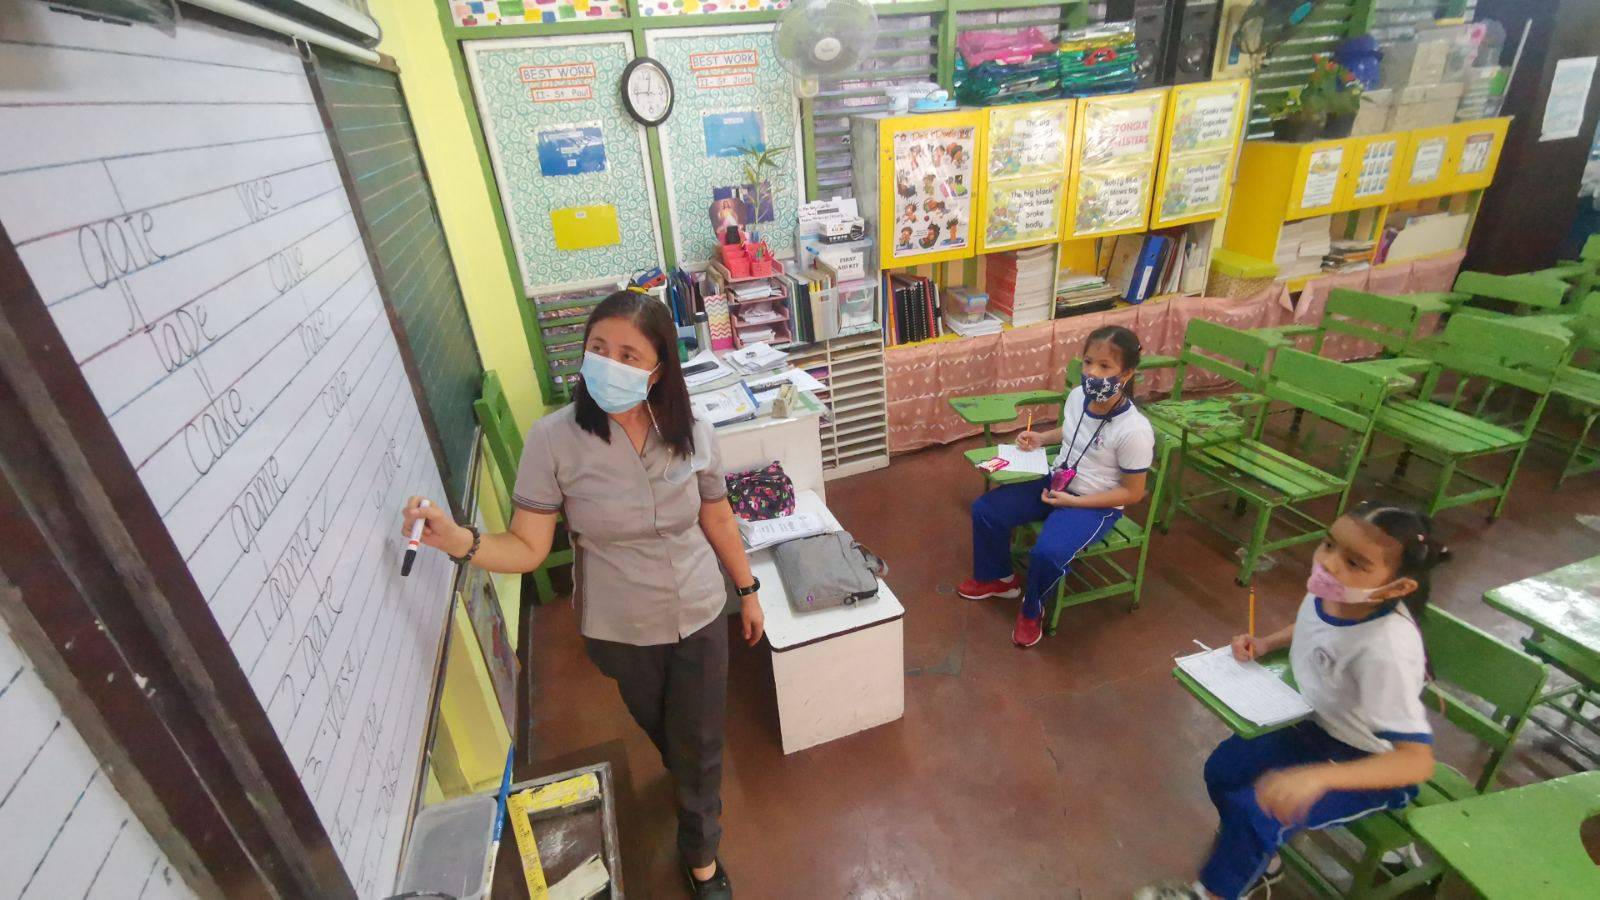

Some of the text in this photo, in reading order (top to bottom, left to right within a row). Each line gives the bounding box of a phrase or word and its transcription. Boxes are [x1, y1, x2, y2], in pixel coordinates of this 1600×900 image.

[693, 53, 754, 67] BEST WORK
[523, 66, 592, 80] BEST WORK
[571, 88, 589, 97] Paul
[837, 263, 847, 271] AID
